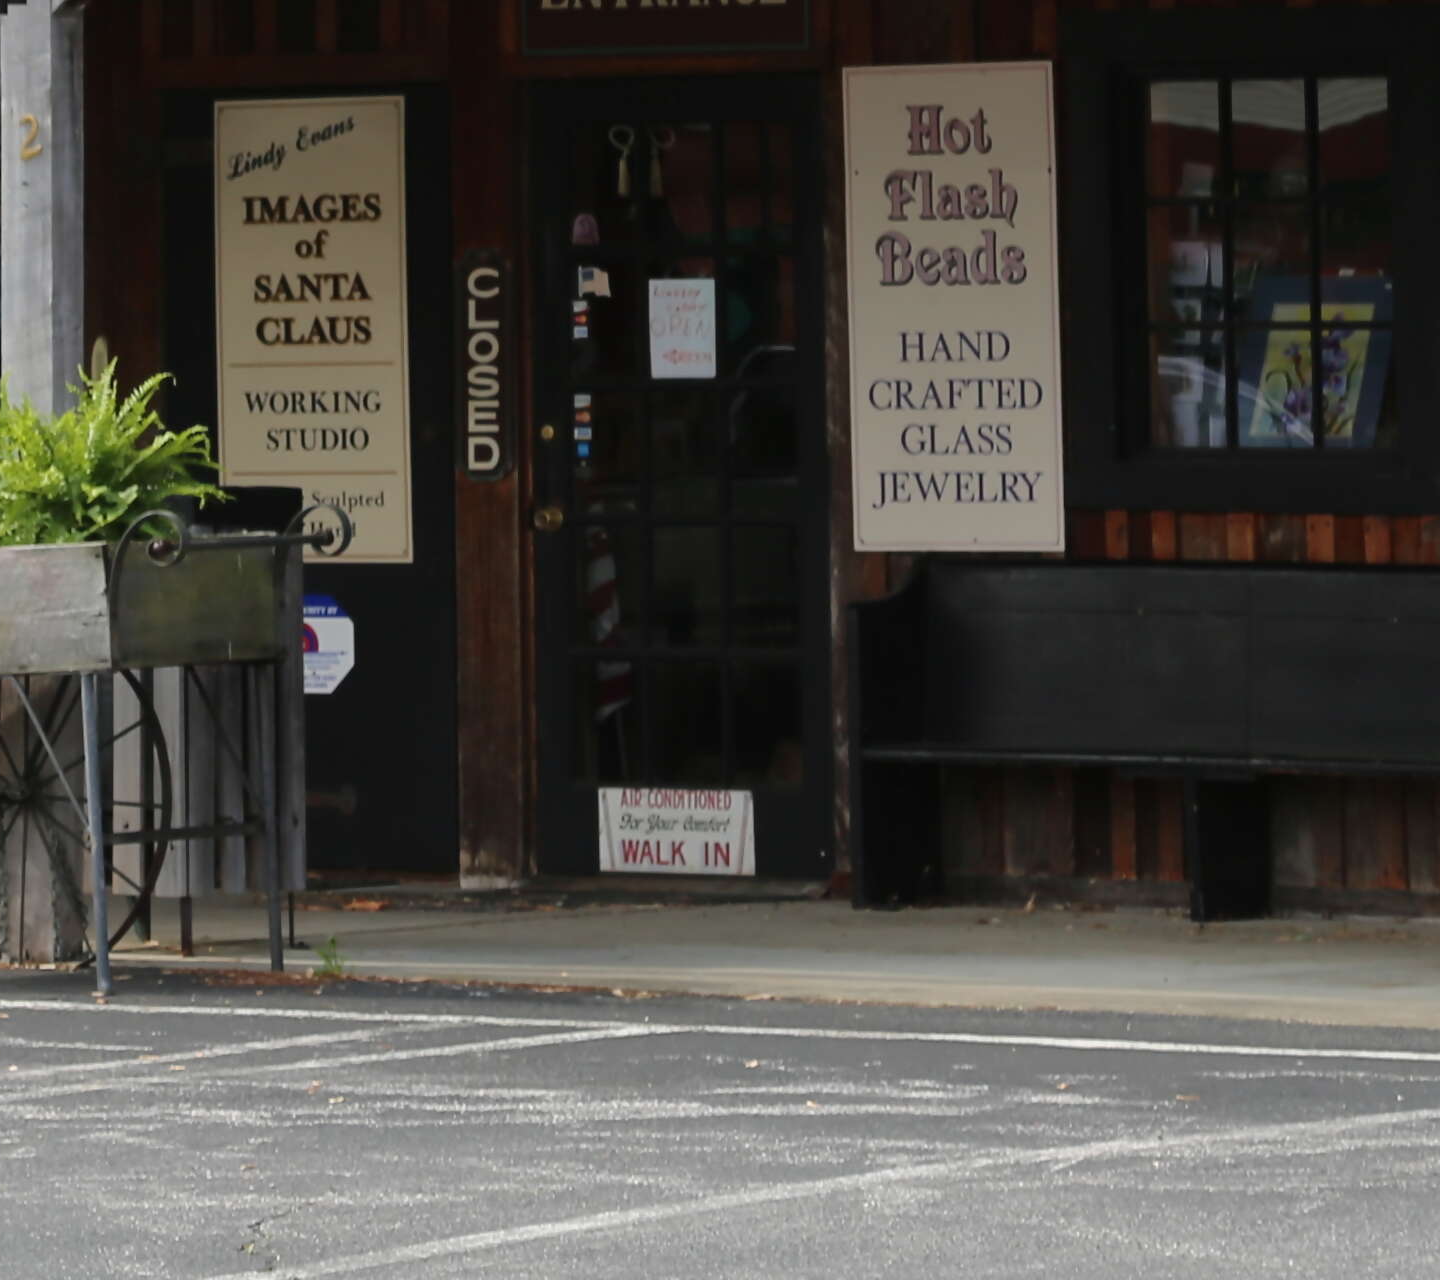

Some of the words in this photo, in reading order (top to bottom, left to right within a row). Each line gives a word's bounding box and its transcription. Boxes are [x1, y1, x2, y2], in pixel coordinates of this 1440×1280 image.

[18, 113, 44, 161] 2
[905, 103, 993, 156] Hot
[226, 142, 287, 181] Lindy
[296, 115, 355, 152] Evans
[242, 192, 383, 225] IMAGES
[884, 168, 1019, 228] Flash
[294, 229, 330, 259] of
[875, 230, 1029, 288] Beads
[254, 272, 371, 305] SANTA
[255, 315, 372, 346] CLAUS
[898, 330, 1010, 363] HAND
[467, 266, 500, 471] CLOSED
[245, 389, 382, 415] WORKING
[868, 377, 1044, 411] CRAFTED
[265, 427, 370, 452] STUDIO
[900, 423, 1013, 456] GLASS
[311, 490, 385, 513] Sculpted
[872, 470, 1044, 510] JEWELRY
[620, 788, 642, 809] AIR
[647, 788, 733, 811] CONDITIONED
[619, 813, 645, 831] For
[645, 814, 679, 835] Your
[620, 839, 687, 866] WALK
[704, 841, 731, 868] IN
